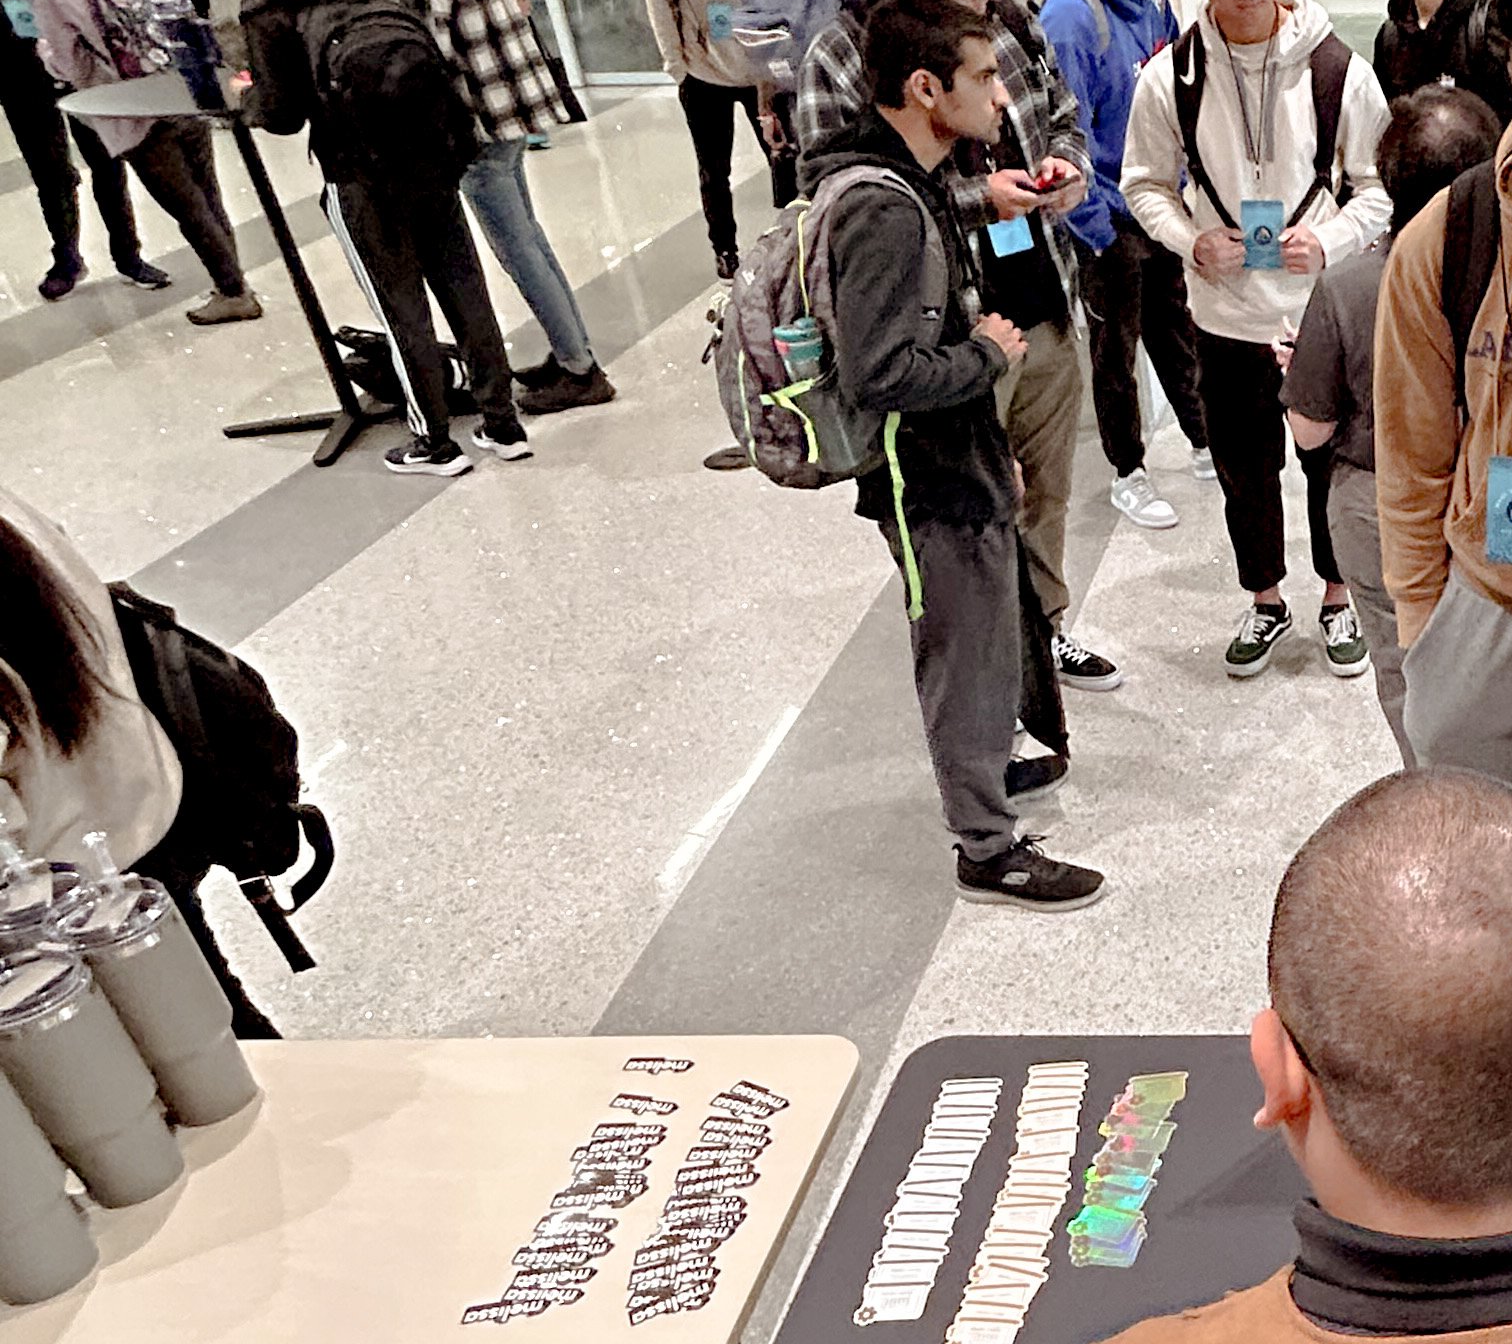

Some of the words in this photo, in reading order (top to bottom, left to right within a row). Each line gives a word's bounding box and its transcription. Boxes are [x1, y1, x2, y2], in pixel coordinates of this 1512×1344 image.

[626, 1058, 690, 1074] melissa
[613, 1096, 677, 1114] melissa
[595, 1124, 665, 1140] melissa
[553, 1188, 625, 1208] melissa
[465, 1301, 544, 1324] melissa
